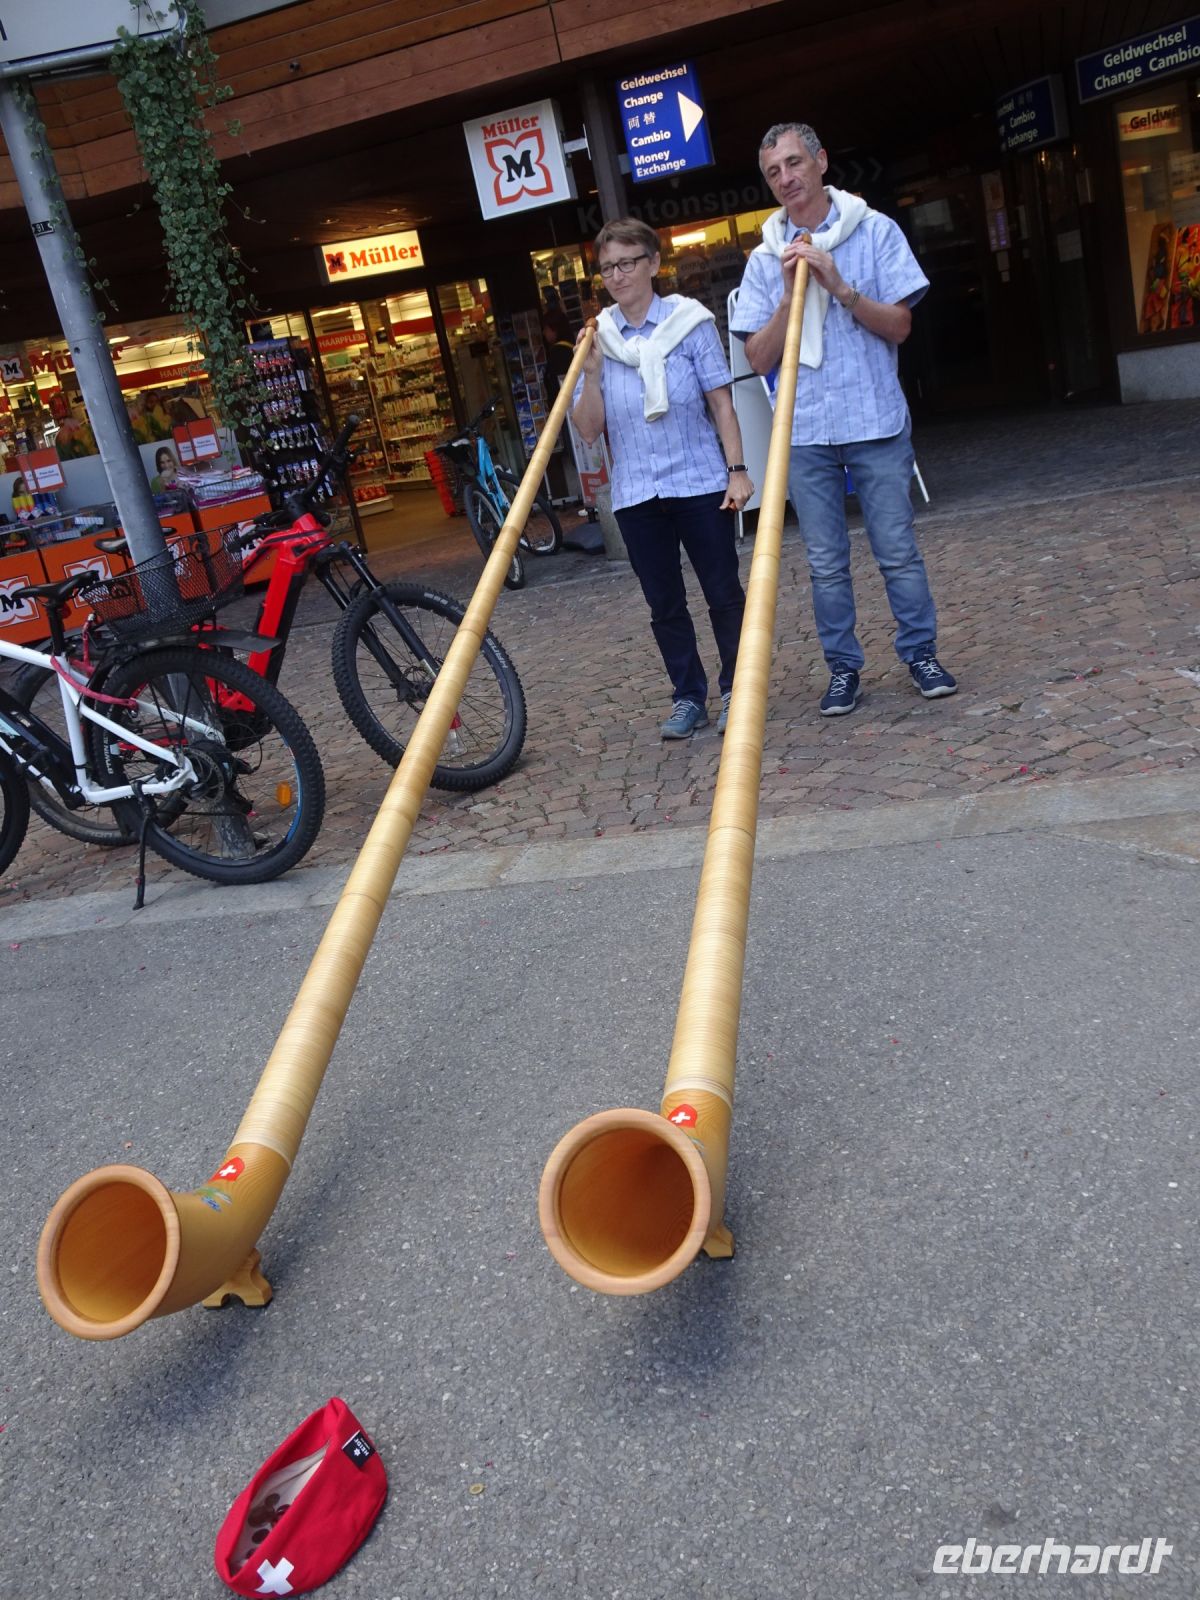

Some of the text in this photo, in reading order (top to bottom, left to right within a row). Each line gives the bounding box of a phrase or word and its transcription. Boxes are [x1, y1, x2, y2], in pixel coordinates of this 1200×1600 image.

[1103, 25, 1187, 68] Geldwechsel
[620, 64, 688, 91] Geldwechsel
[1094, 44, 1200, 91] Change Cambio
[624, 91, 664, 109] Change
[481, 115, 540, 140] Müller
[631, 130, 672, 148] Cambio
[502, 149, 536, 182] M
[634, 150, 671, 167] Money
[636, 158, 687, 178] Exchange
[349, 245, 419, 269] Müller
[4, 362, 19, 375] M
